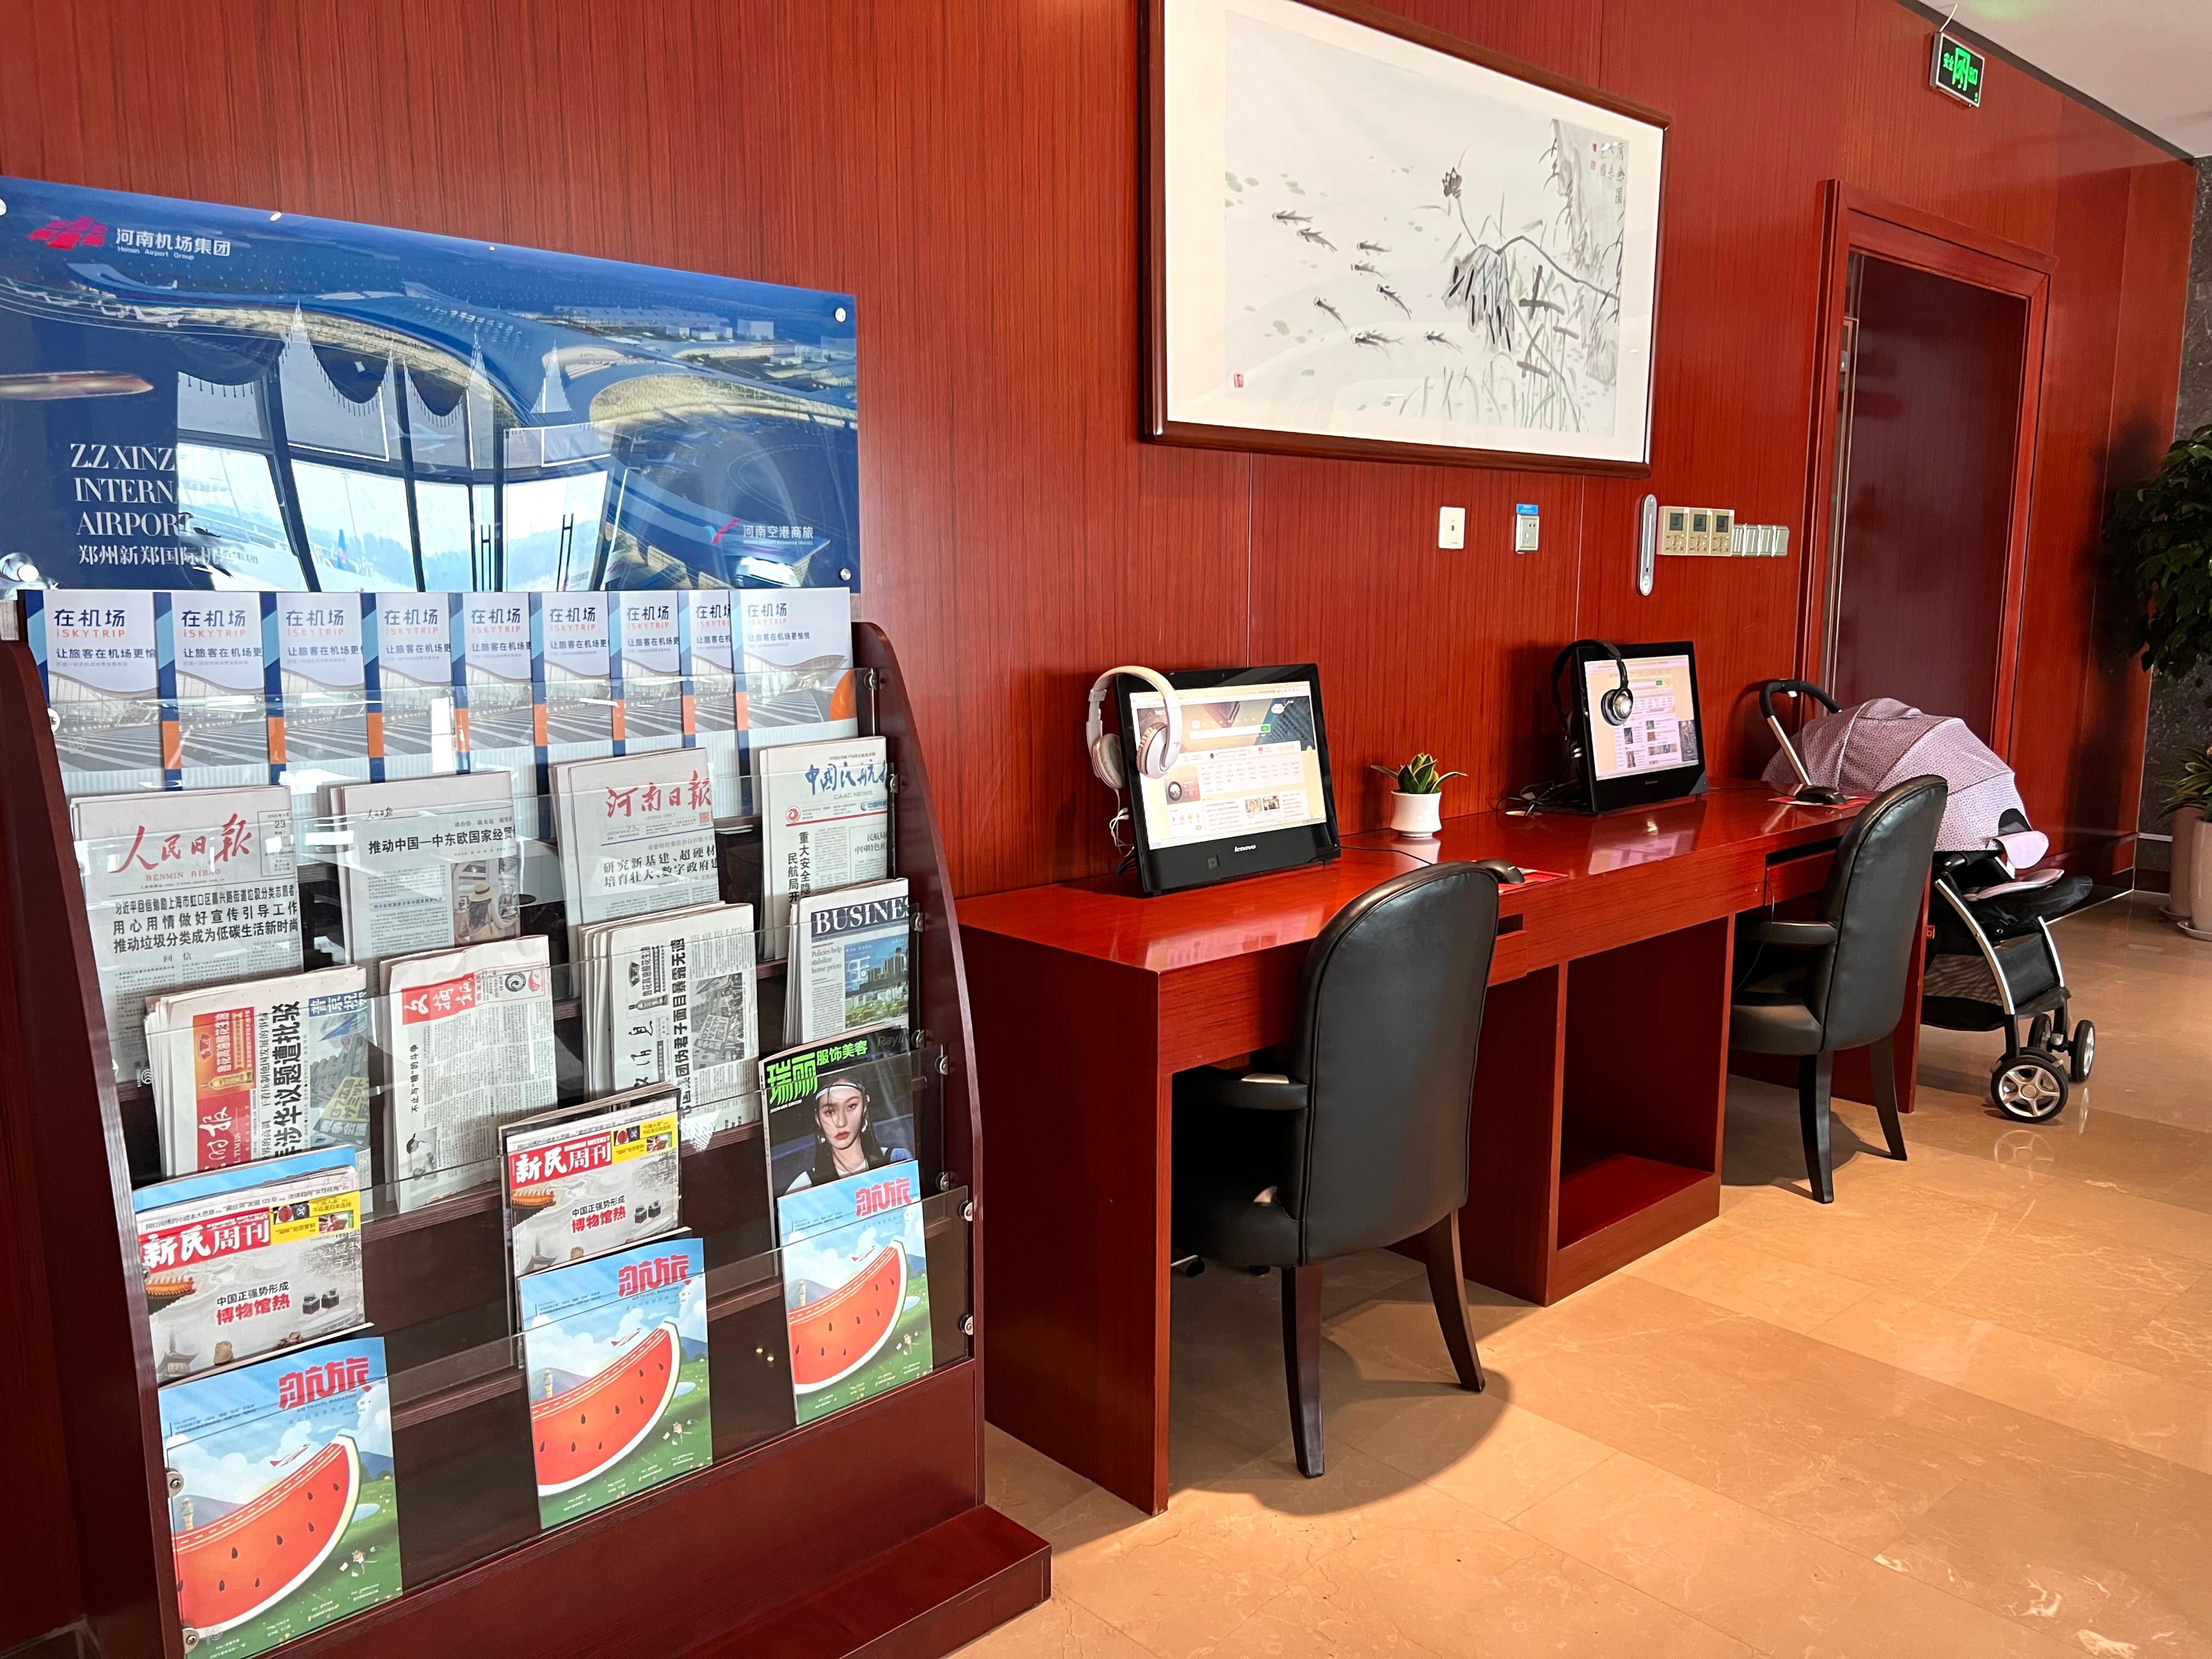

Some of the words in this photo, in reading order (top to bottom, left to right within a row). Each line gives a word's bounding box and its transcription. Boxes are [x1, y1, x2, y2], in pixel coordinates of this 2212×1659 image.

[116, 228, 230, 257] 河南机场集团
[117, 246, 139, 254] Henan
[144, 249, 168, 257] Airport
[173, 252, 194, 261] Group
[76, 511, 194, 537] AIRPORT
[743, 524, 814, 539] 河南空港商旅
[54, 608, 126, 628] 在机场
[181, 610, 246, 628] 在机场
[286, 609, 343, 627] 在机场
[384, 608, 438, 625] 在机场
[471, 608, 521, 624] 在机场
[549, 607, 595, 623] 在机场
[627, 606, 669, 621] 在机场
[747, 602, 787, 618] 在机场
[550, 638, 610, 650] 让旅客在机场更
[748, 631, 810, 642] 让旅客在机场更愉悦
[287, 644, 363, 657] 让旅客在机场更
[274, 820, 286, 828] 23
[867, 831, 887, 841] 民航局
[1234, 843, 1256, 853] lenovo
[799, 831, 811, 898] 重大安全隐
[146, 872, 184, 882] RENMIN
[788, 853, 799, 903] 民航局开
[113, 900, 297, 935] 用心用情做好宣传引导工作
[113, 918, 298, 953] 推动垃圾分类成为低碳生活新时尚
[831, 945, 843, 955] help
[811, 966, 827, 974] home
[827, 963, 842, 972] prices
[215, 1013, 232, 1073] 鲁花高油酸花生油
[816, 1040, 868, 1066] 服饰美容
[766, 1052, 819, 1105] 瑞丽
[199, 1106, 233, 1167] 时报
[587, 1135, 611, 1146] WEEKLY
[516, 1142, 611, 1184] 新民周刊
[572, 1195, 625, 1217] 中国正强势形成
[571, 1205, 627, 1234] 博物馆热
[143, 1220, 269, 1268] 新民周刊
[217, 1281, 290, 1306] 中国正强势形成
[216, 1293, 291, 1326] 博物馆热
[307, 1401, 327, 1410] TRAVEL
